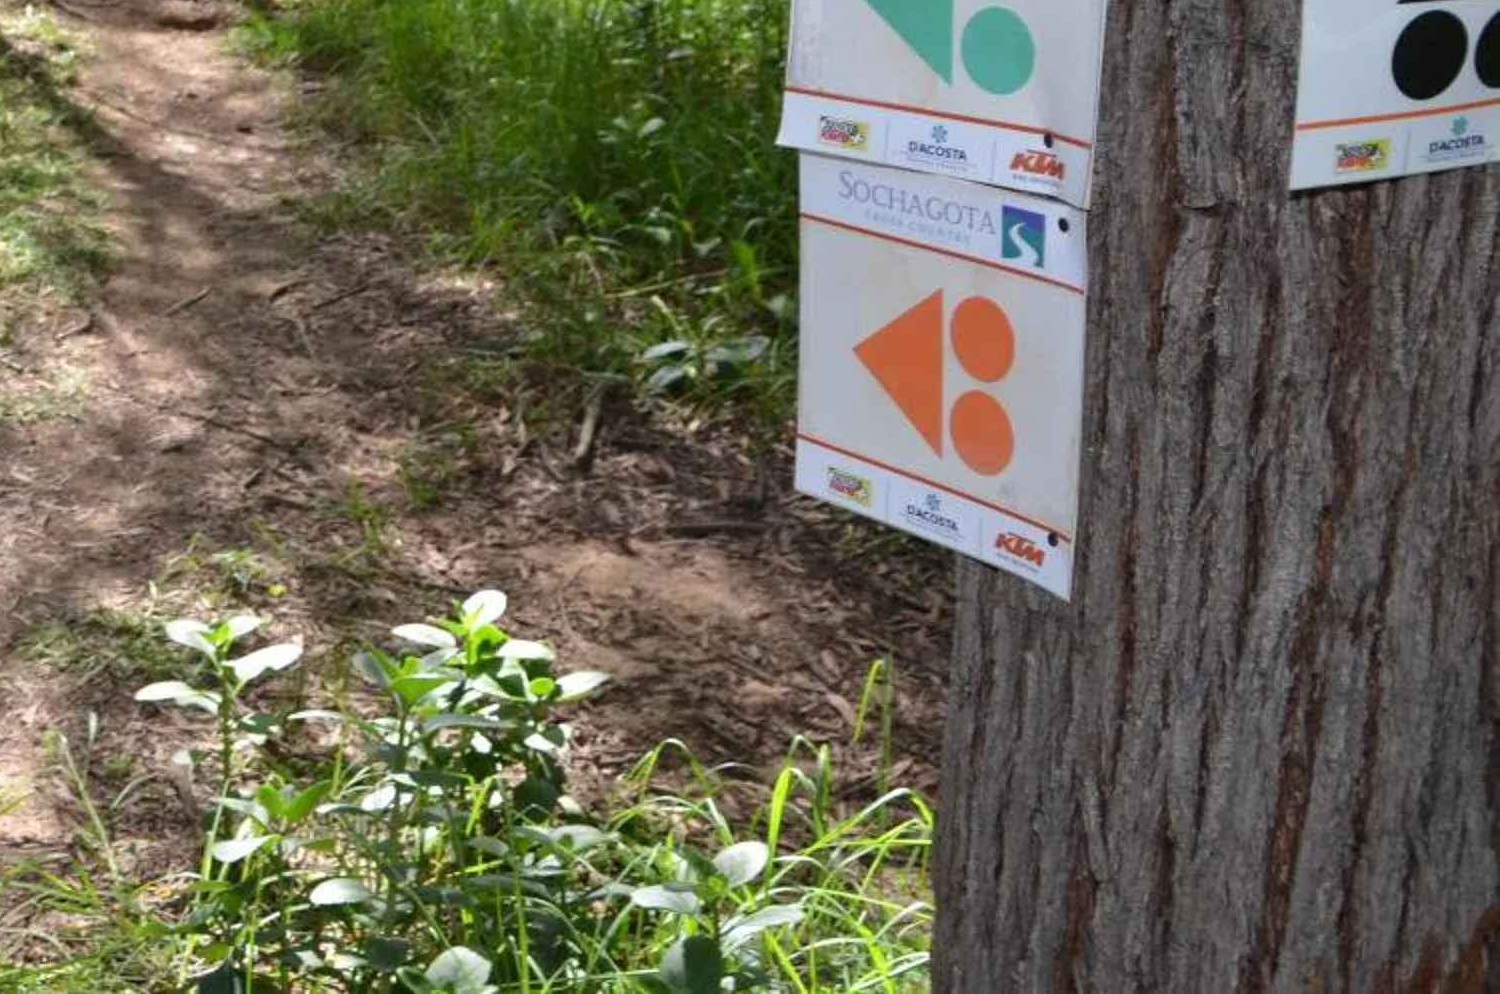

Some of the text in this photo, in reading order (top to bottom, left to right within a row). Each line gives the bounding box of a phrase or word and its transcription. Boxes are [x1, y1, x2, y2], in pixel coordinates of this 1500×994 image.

[1009, 149, 1065, 181] KTM
[838, 169, 996, 235] SOCHAGOTA
[995, 532, 1045, 567] KTM
